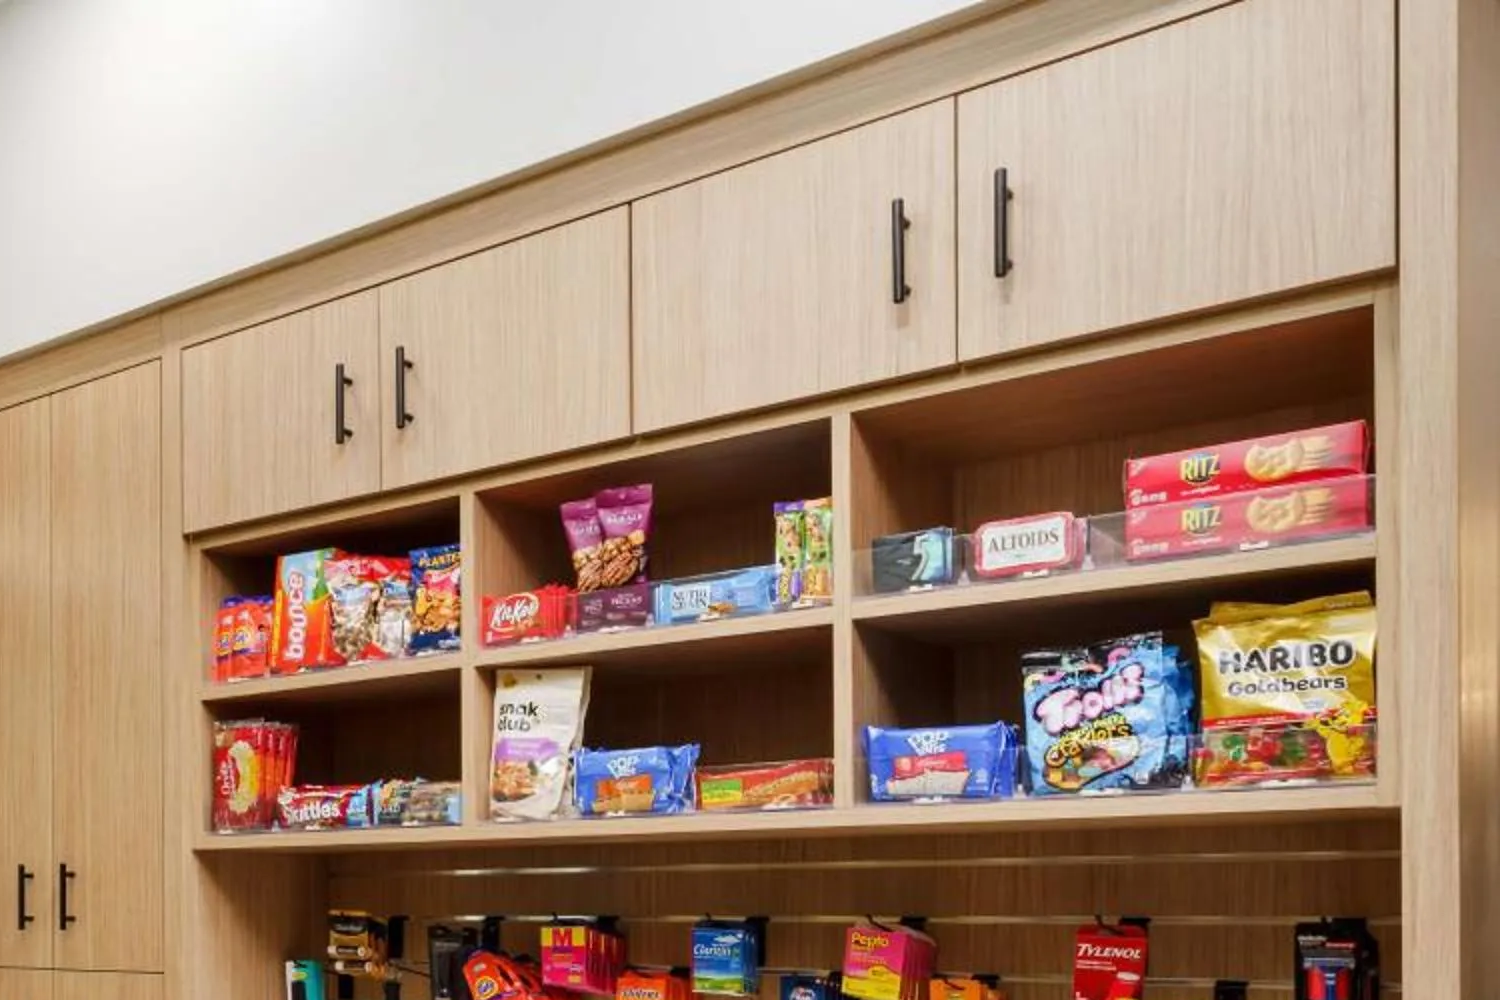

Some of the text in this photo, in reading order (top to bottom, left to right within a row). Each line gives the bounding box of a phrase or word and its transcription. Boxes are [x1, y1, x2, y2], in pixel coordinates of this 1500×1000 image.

[1180, 454, 1220, 480] RITZ
[1182, 505, 1222, 532] RITZ
[988, 528, 1060, 553] ALTOIDS
[285, 571, 307, 661] bounce
[1218, 640, 1354, 675] HARIBO
[1228, 675, 1346, 697] Goldbears
[283, 802, 341, 826] Skittles
[1077, 943, 1142, 960] TYLENOL
